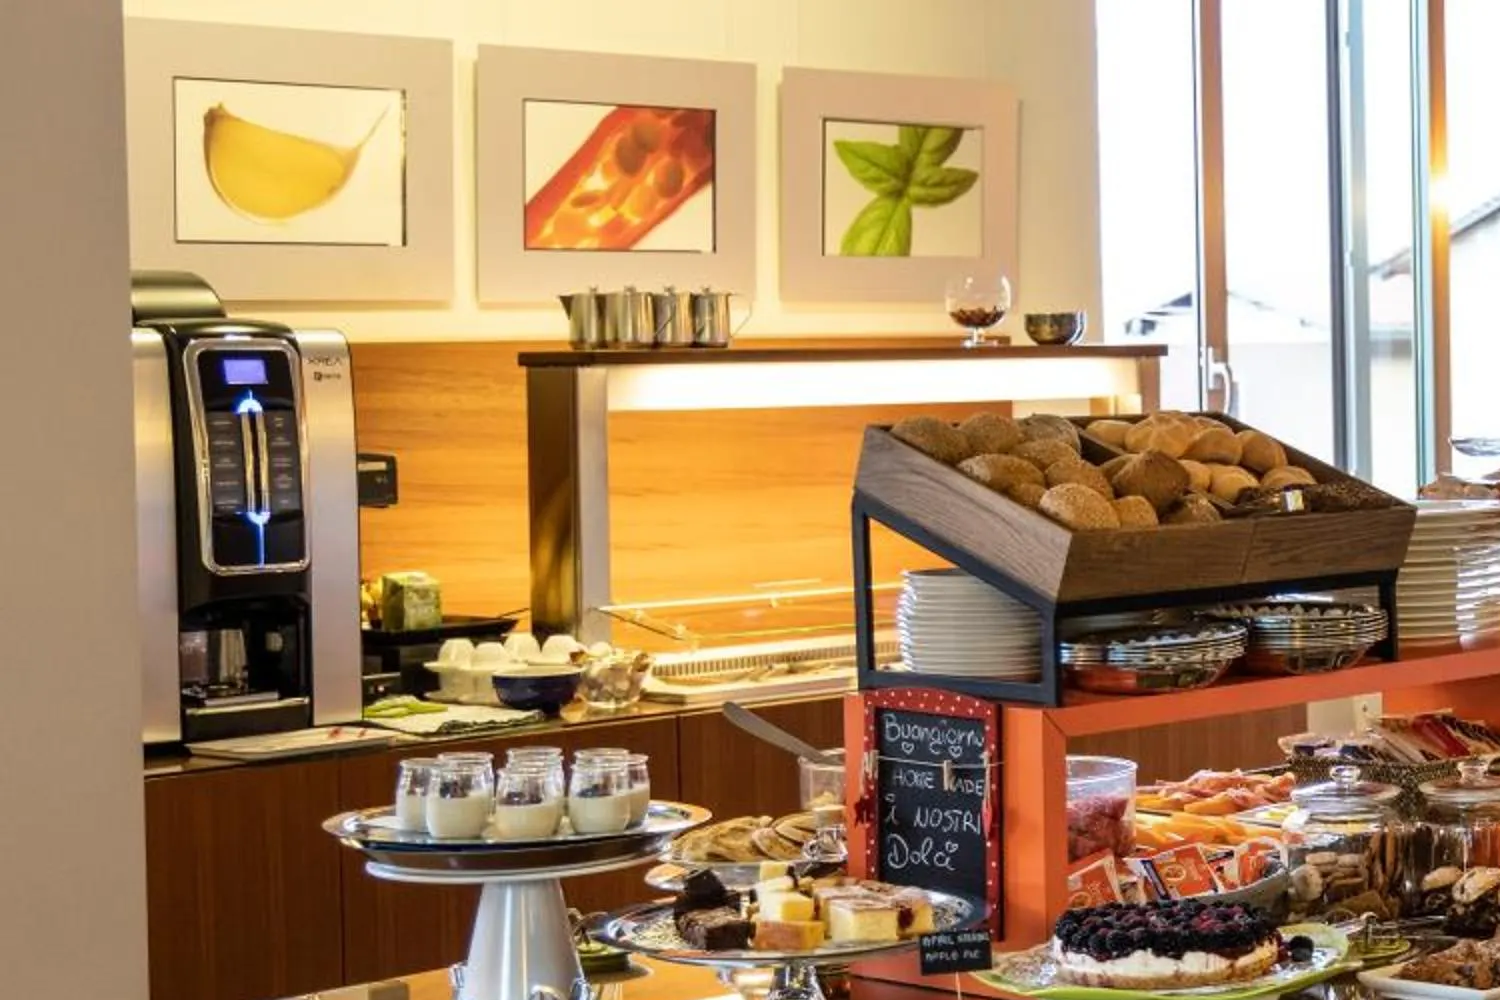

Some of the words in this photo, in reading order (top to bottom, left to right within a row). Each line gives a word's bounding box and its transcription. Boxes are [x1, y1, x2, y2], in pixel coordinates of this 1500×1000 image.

[893, 768, 935, 789] HOME
[946, 775, 985, 796] ADE
[914, 808, 981, 835] NOSTRI
